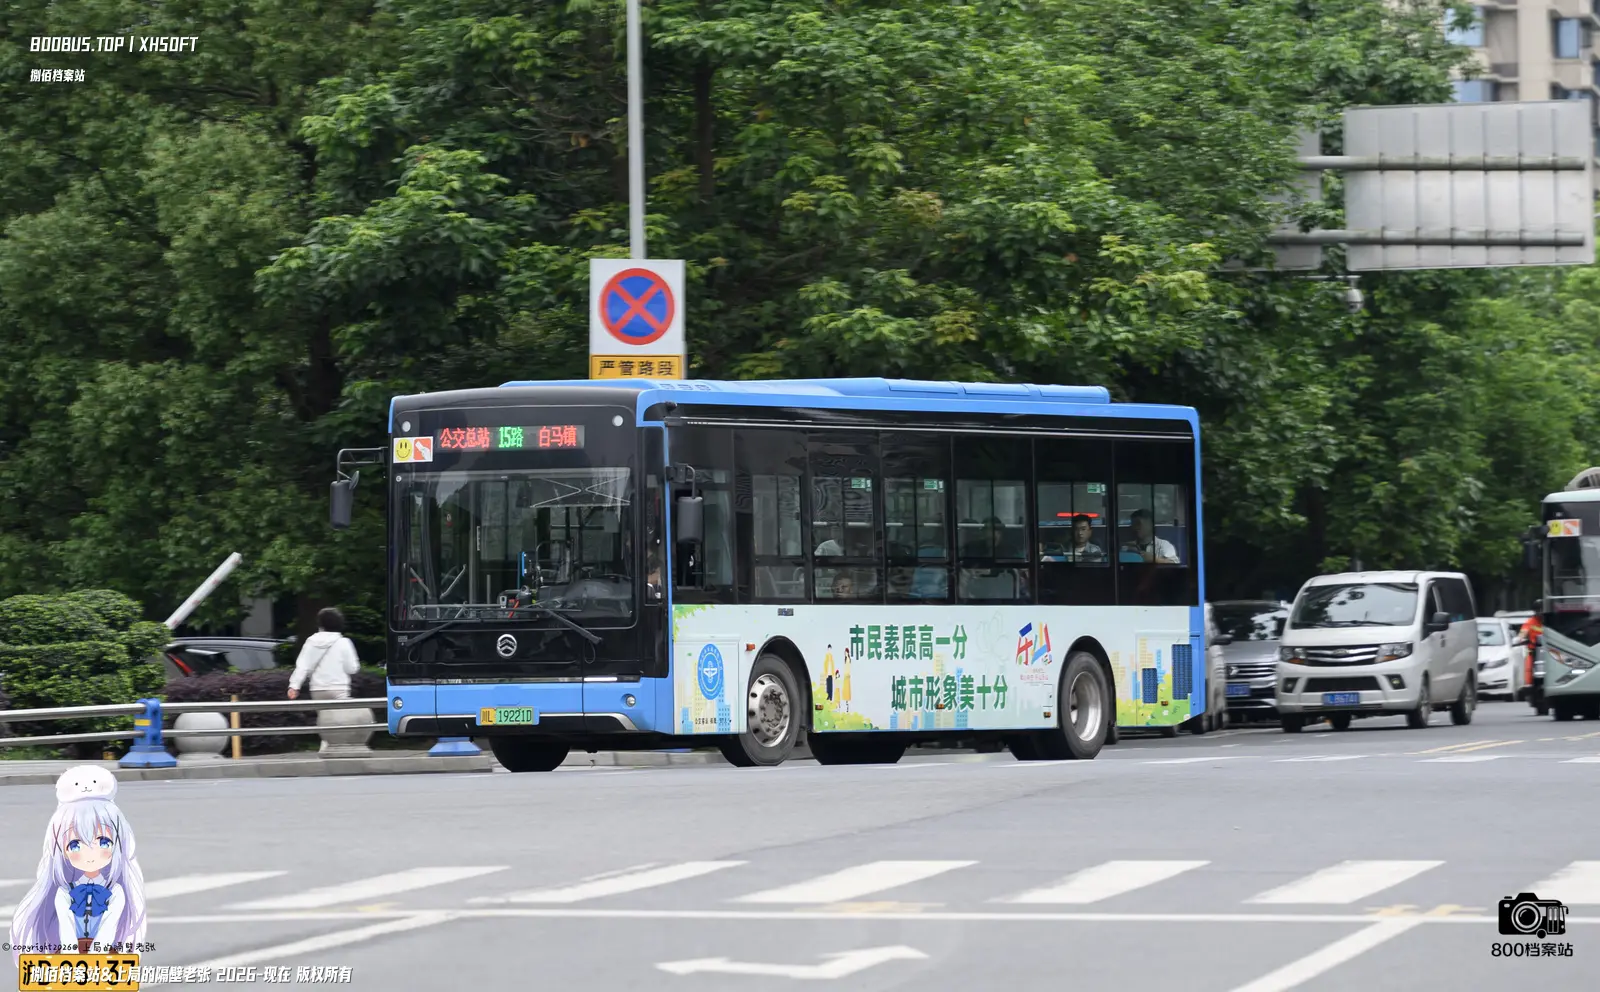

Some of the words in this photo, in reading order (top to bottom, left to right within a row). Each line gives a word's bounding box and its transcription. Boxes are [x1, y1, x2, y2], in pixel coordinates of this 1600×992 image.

[598, 360, 675, 376] 严管路段
[440, 427, 490, 449] 公交总站
[498, 426, 524, 449] 15路
[538, 425, 578, 447] 白马镇
[849, 624, 968, 661] 市民素质高一分
[891, 674, 1009, 711] 城市形象美十分
